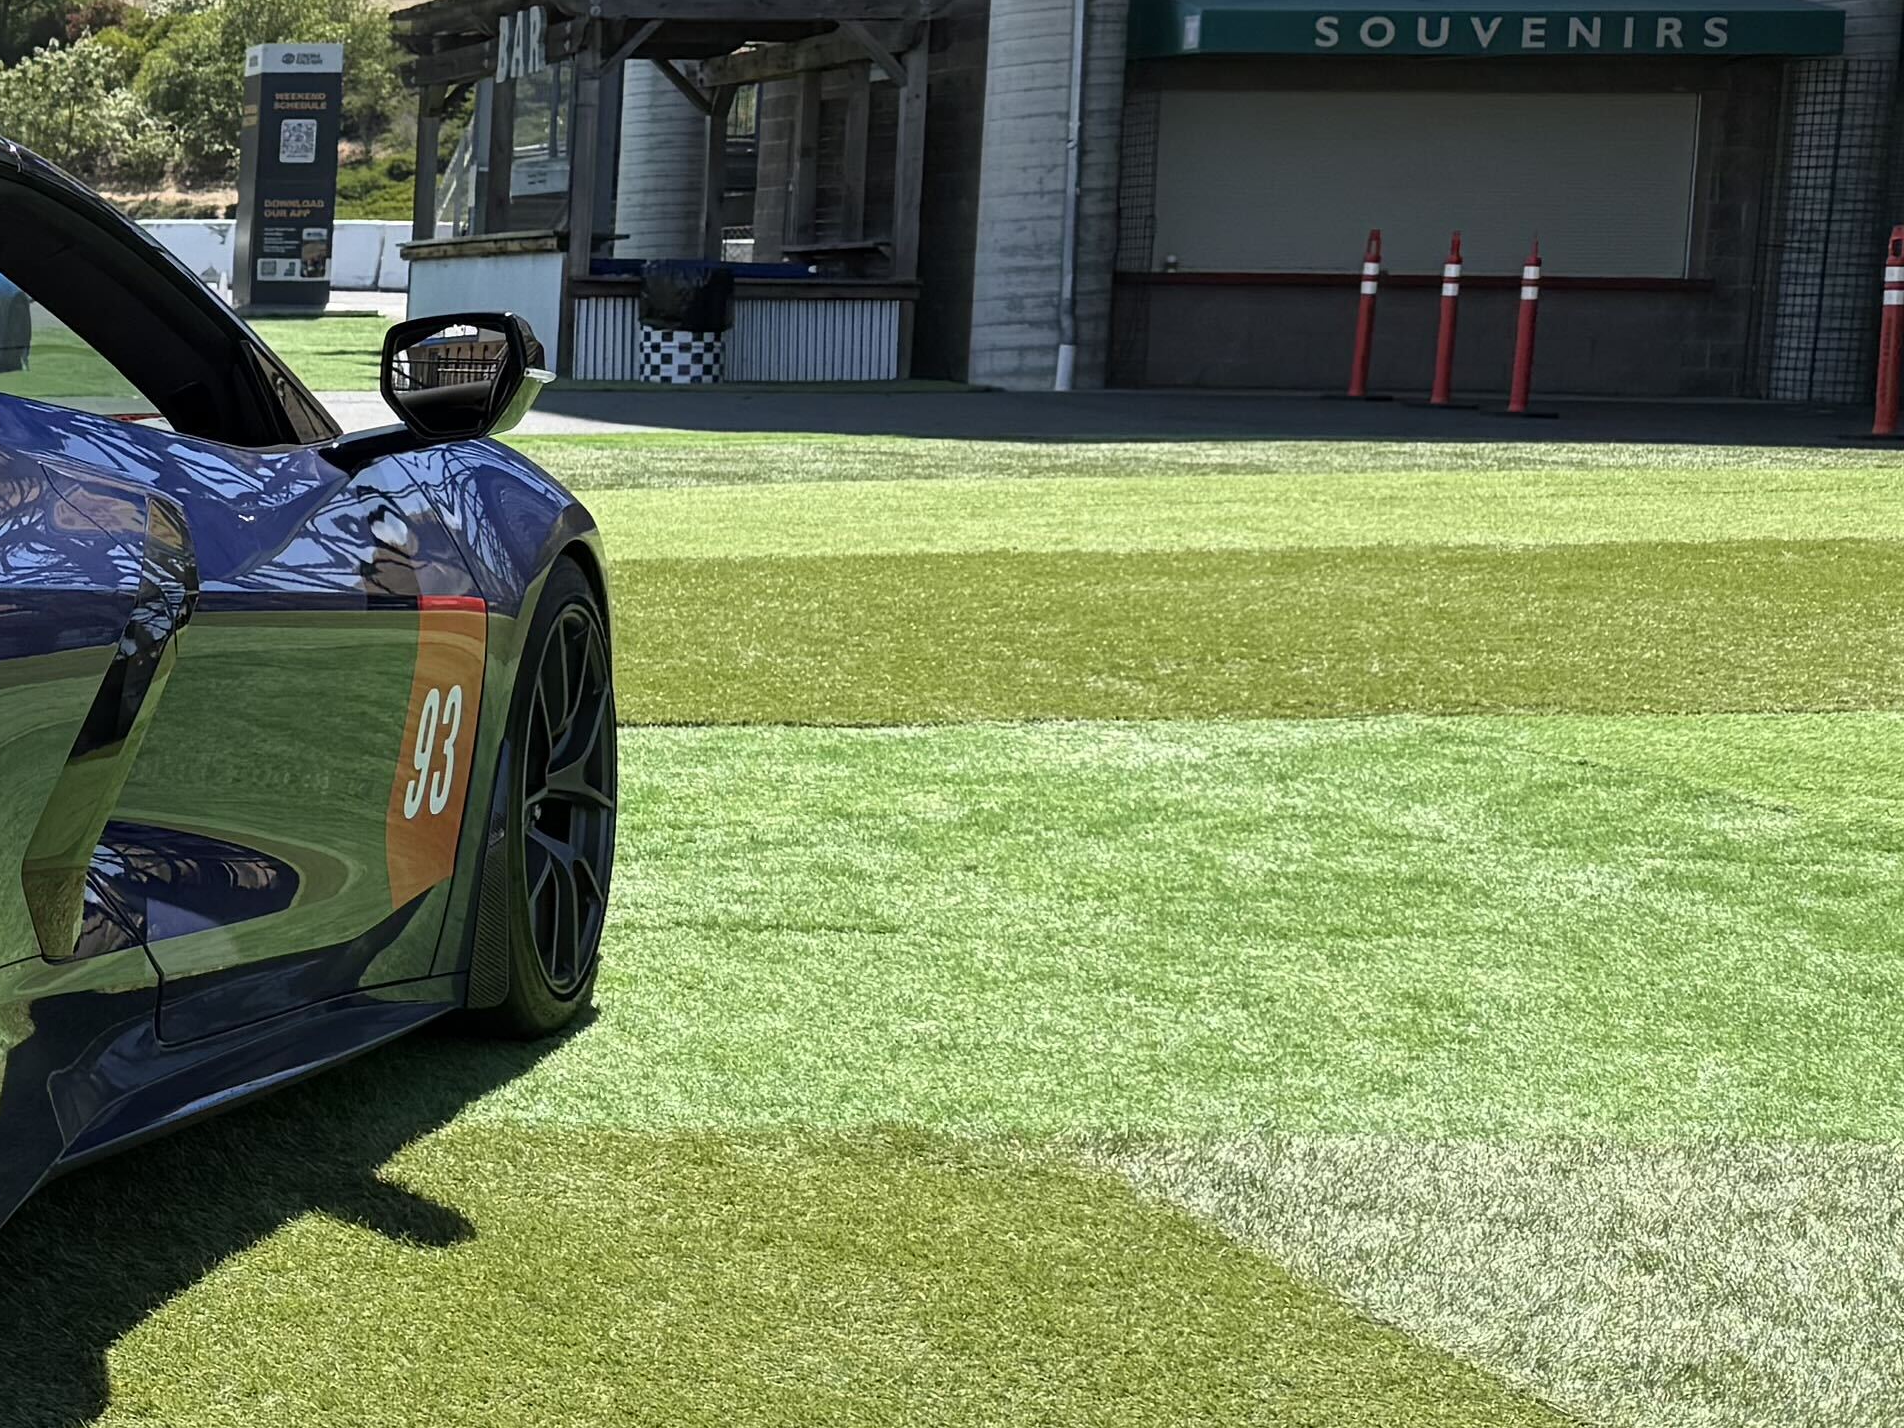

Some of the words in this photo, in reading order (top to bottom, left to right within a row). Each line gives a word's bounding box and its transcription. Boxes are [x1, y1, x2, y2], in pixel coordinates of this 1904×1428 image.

[1314, 15, 1730, 50] SOUVENIRS
[496, 6, 545, 83] BAR
[275, 92, 326, 101] WEEKEND
[273, 101, 328, 110] SCHEDULE
[264, 199, 325, 208] DOWNLOAD
[264, 209, 288, 218] OUR
[289, 209, 311, 218] APP
[403, 684, 462, 820] 93
